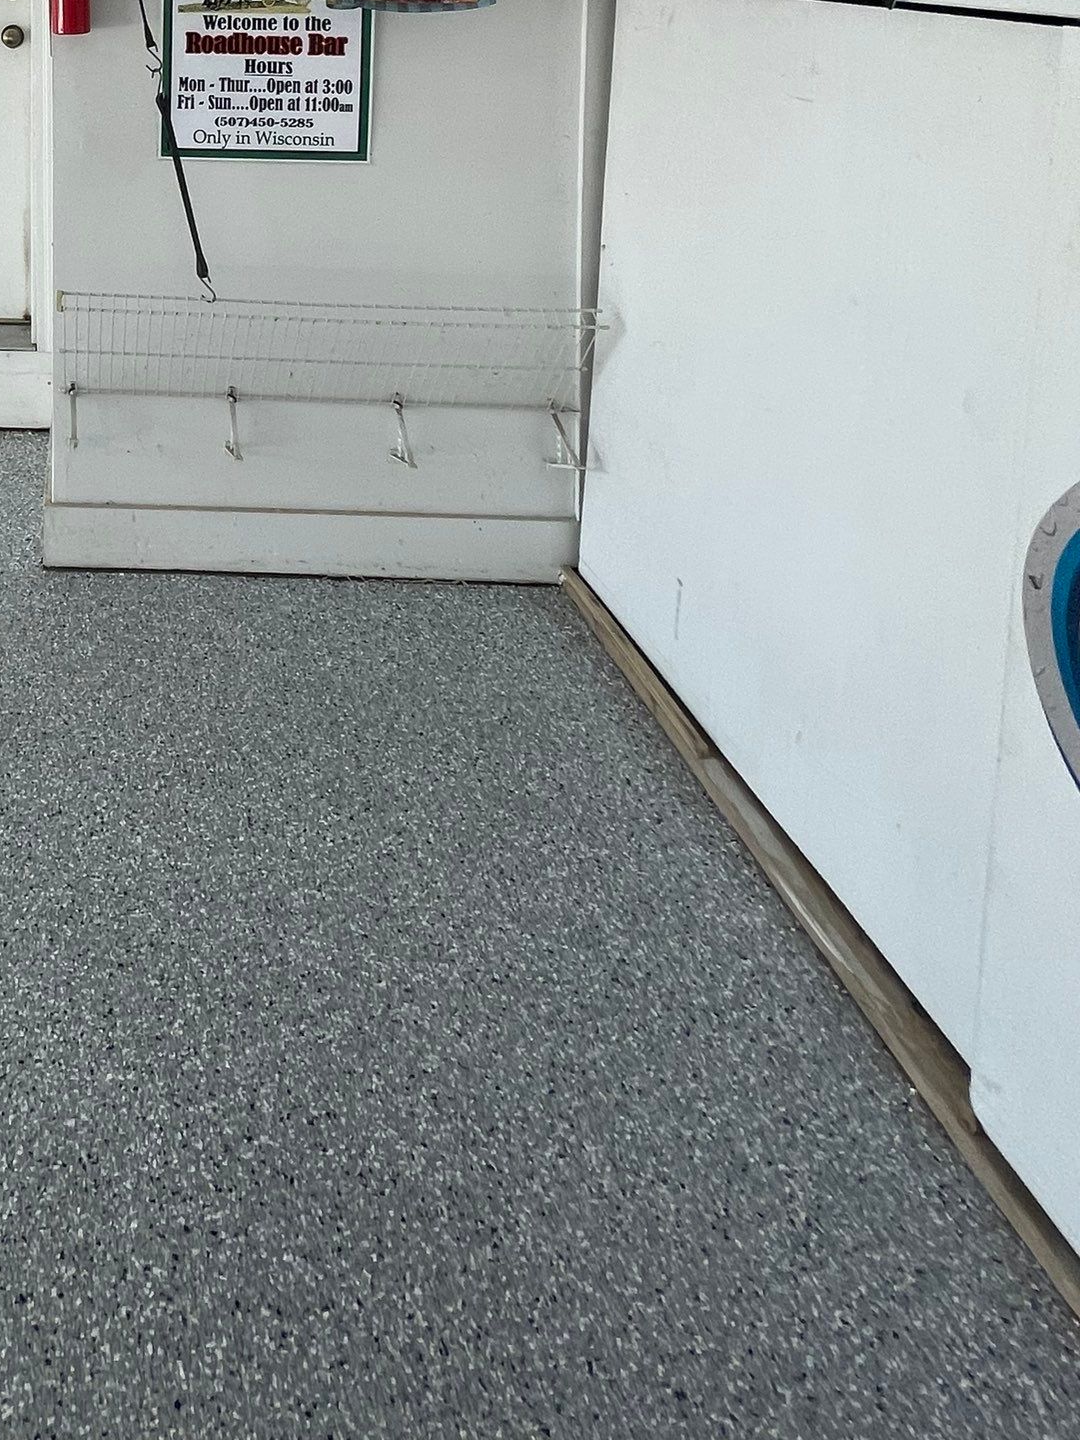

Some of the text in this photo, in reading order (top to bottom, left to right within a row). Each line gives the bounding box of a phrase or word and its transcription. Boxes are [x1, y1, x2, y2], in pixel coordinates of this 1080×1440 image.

[203, 14, 332, 32] Welcome to the
[185, 31, 349, 57] Roadhouse Bar
[244, 59, 294, 76] Hours
[179, 76, 206, 92] Mon
[304, 79, 319, 94] at
[322, 79, 353, 95] 3:00
[177, 94, 195, 110] Fri
[287, 97, 301, 112] at
[304, 97, 354, 113] 11:00am
[214, 116, 315, 129] (507)450-5285
[193, 129, 336, 148] Only in Wisconsin
